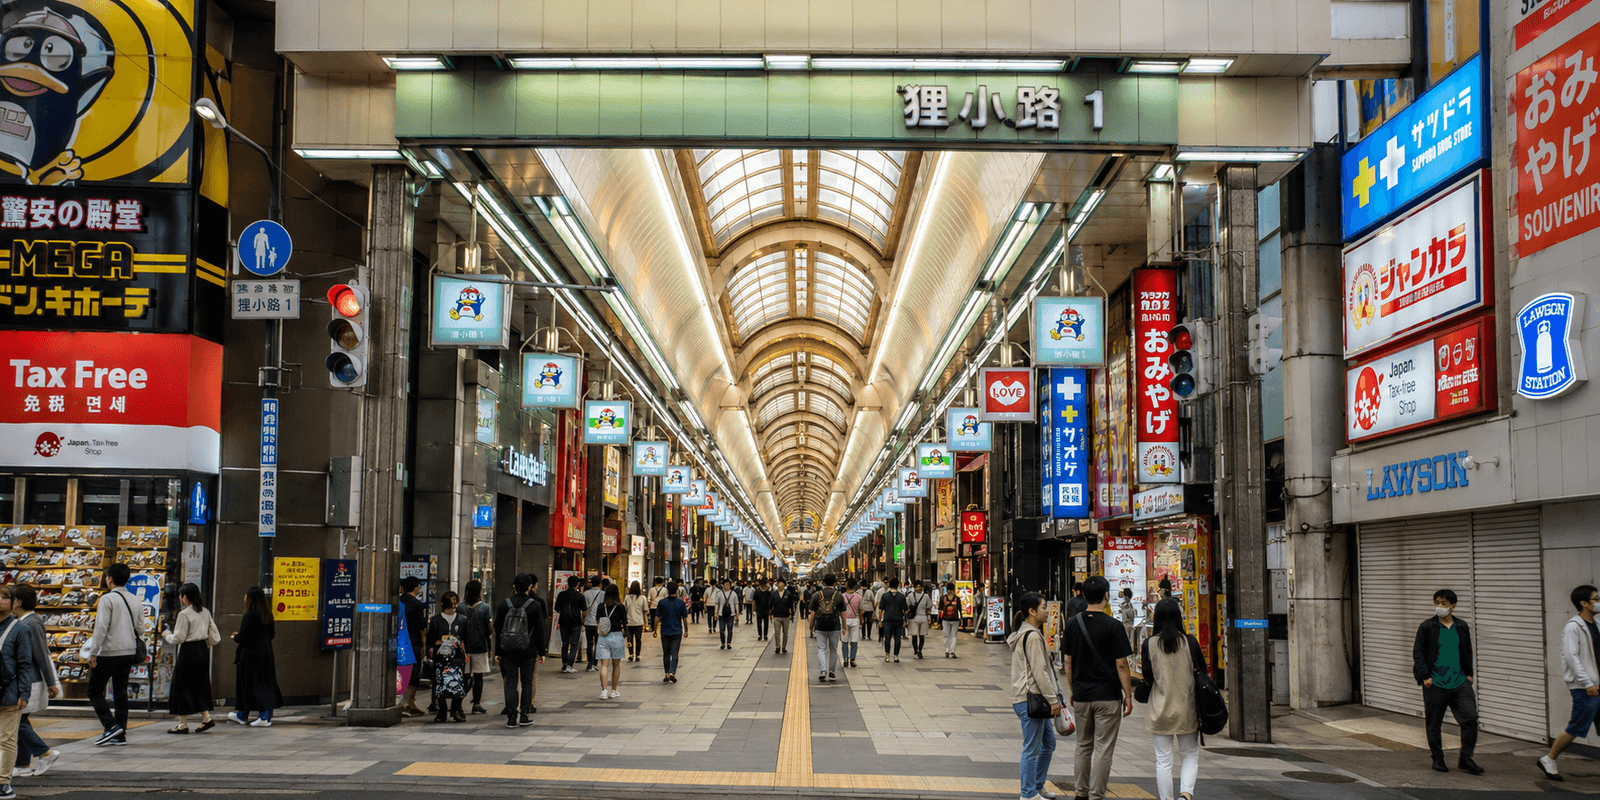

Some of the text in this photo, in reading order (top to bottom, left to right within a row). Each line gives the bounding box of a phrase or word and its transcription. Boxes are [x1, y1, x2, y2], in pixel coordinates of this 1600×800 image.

[901, 84, 1104, 131] 狸小路 1
[1524, 50, 1598, 130] おみ
[1411, 86, 1471, 149] サツドラ
[1524, 106, 1600, 195] やげ
[1, 196, 142, 230] 驚安の殿堂
[11, 239, 134, 280] MEGA
[1380, 222, 1466, 301] ジャンカラ
[284, 298, 291, 311] 1
[1523, 303, 1565, 328] LAWSON
[10, 359, 148, 389] Tax Free
[1143, 328, 1171, 435] おみやげ
[1389, 359, 1416, 378] Japan.
[1525, 366, 1566, 390] STATION
[993, 388, 1023, 399] LOVE
[1366, 451, 1469, 501] LAWSON
